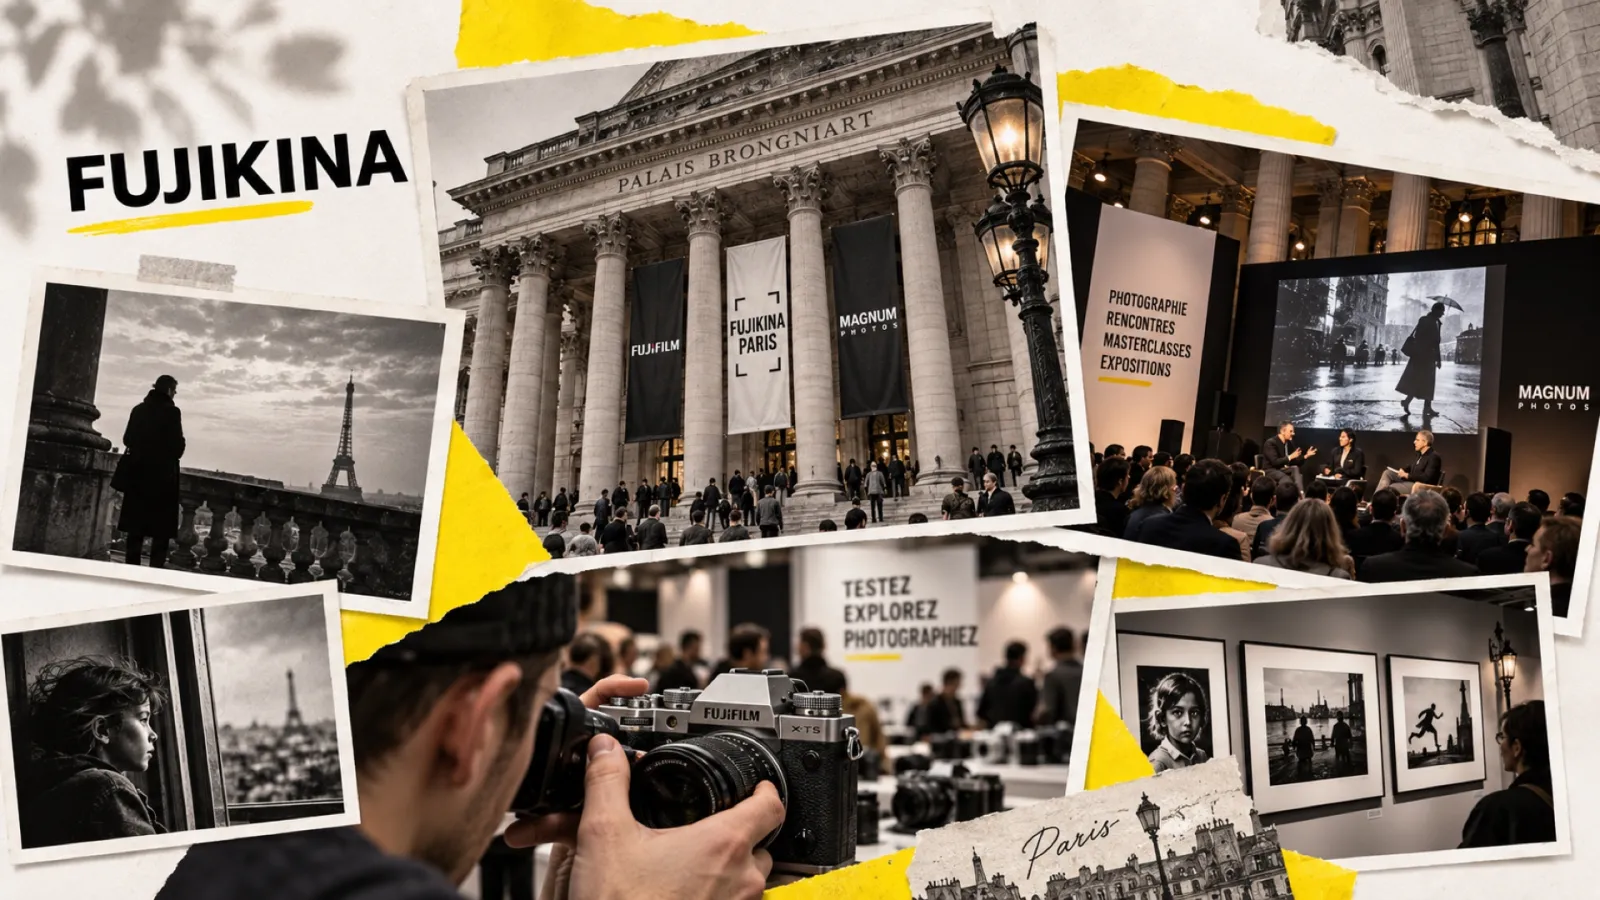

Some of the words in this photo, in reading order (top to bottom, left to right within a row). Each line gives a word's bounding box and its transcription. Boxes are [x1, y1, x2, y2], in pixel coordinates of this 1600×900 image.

[618, 159, 694, 193] PALAIS
[709, 110, 874, 169] BRONGNIART
[1108, 289, 1188, 316] PHOTOGRAPHIE
[730, 312, 785, 336] FUJIKINA
[839, 306, 897, 328] MAGNUM
[1106, 310, 1175, 335] RENCONTRES
[840, 322, 898, 336] PHOTOS
[739, 333, 777, 354] PARIS
[1103, 332, 1192, 358] MASTERCLASSES
[1100, 354, 1171, 377] EXPOSITIONS
[1518, 384, 1590, 400] MAGNUM
[1518, 402, 1590, 411] PHOTOS
[842, 575, 911, 598] TESTEZ
[844, 600, 938, 623] EXPLOREZ
[844, 625, 979, 648] PHOTOGRAPHIEZ
[1022, 819, 1120, 880] Paris
